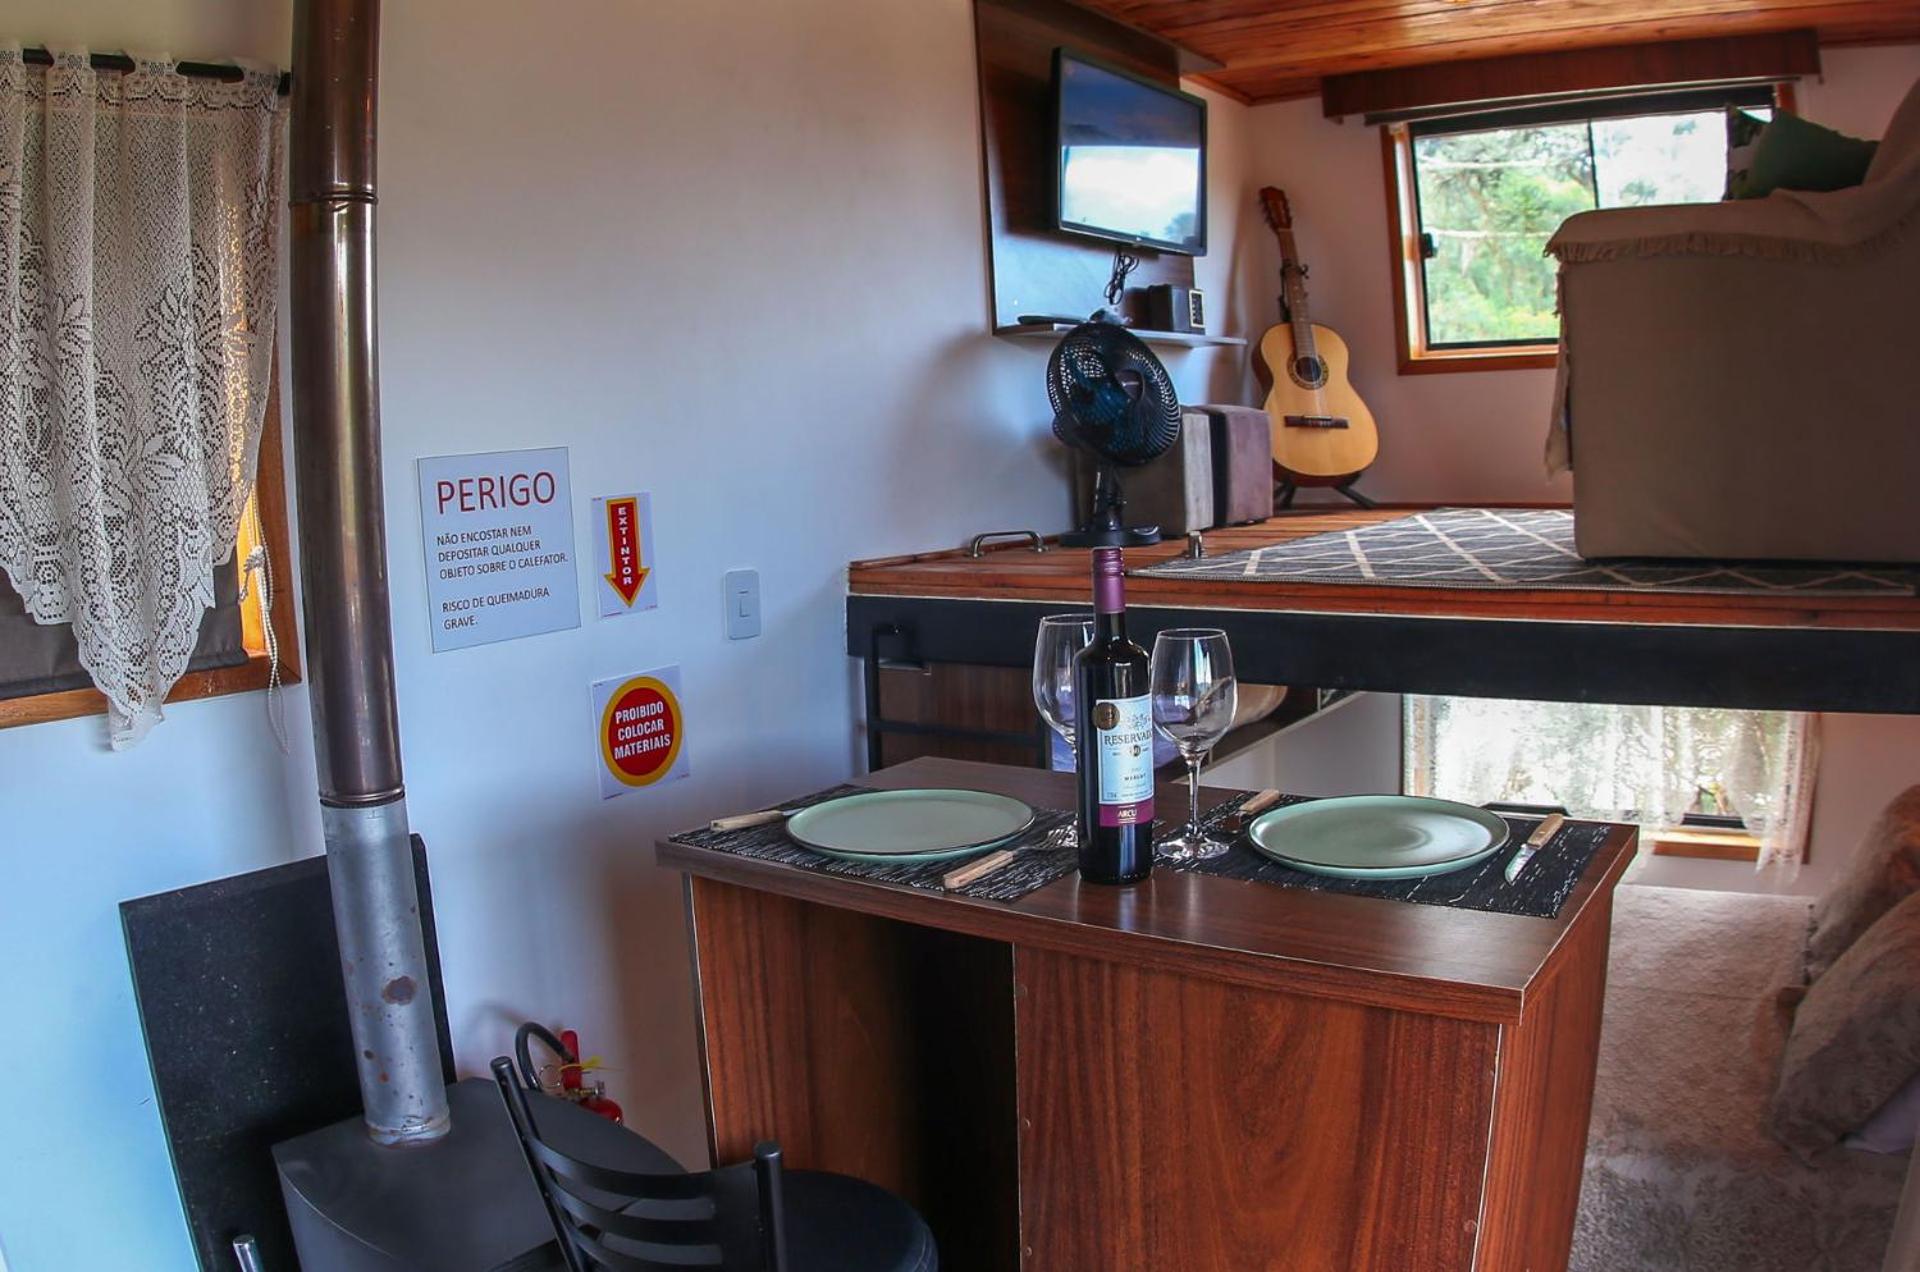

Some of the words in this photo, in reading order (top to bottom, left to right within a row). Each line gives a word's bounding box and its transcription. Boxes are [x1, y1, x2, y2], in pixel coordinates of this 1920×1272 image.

[437, 471, 556, 515] PERIGO
[436, 532, 458, 546] NÃO
[461, 528, 509, 544] ENCOSTAR
[510, 525, 532, 537] NEM
[617, 506, 633, 586] EXTINTOR
[438, 547, 489, 562] DEPOSITAR
[491, 539, 541, 556] QUALQUER
[439, 565, 475, 580] OBJETO
[477, 560, 507, 575] SOBRE
[508, 560, 517, 570] O
[518, 552, 569, 569] CALEFATOR.
[442, 599, 471, 613] RISCO
[472, 596, 485, 608] DE
[487, 586, 551, 606] QUEIMADURA
[443, 615, 479, 630] GRAVE.
[615, 701, 664, 724] PROIBIDO
[618, 719, 665, 741] COLOCAR
[1104, 730, 1152, 746] RESERVAD
[614, 734, 671, 760] MATERIAIS
